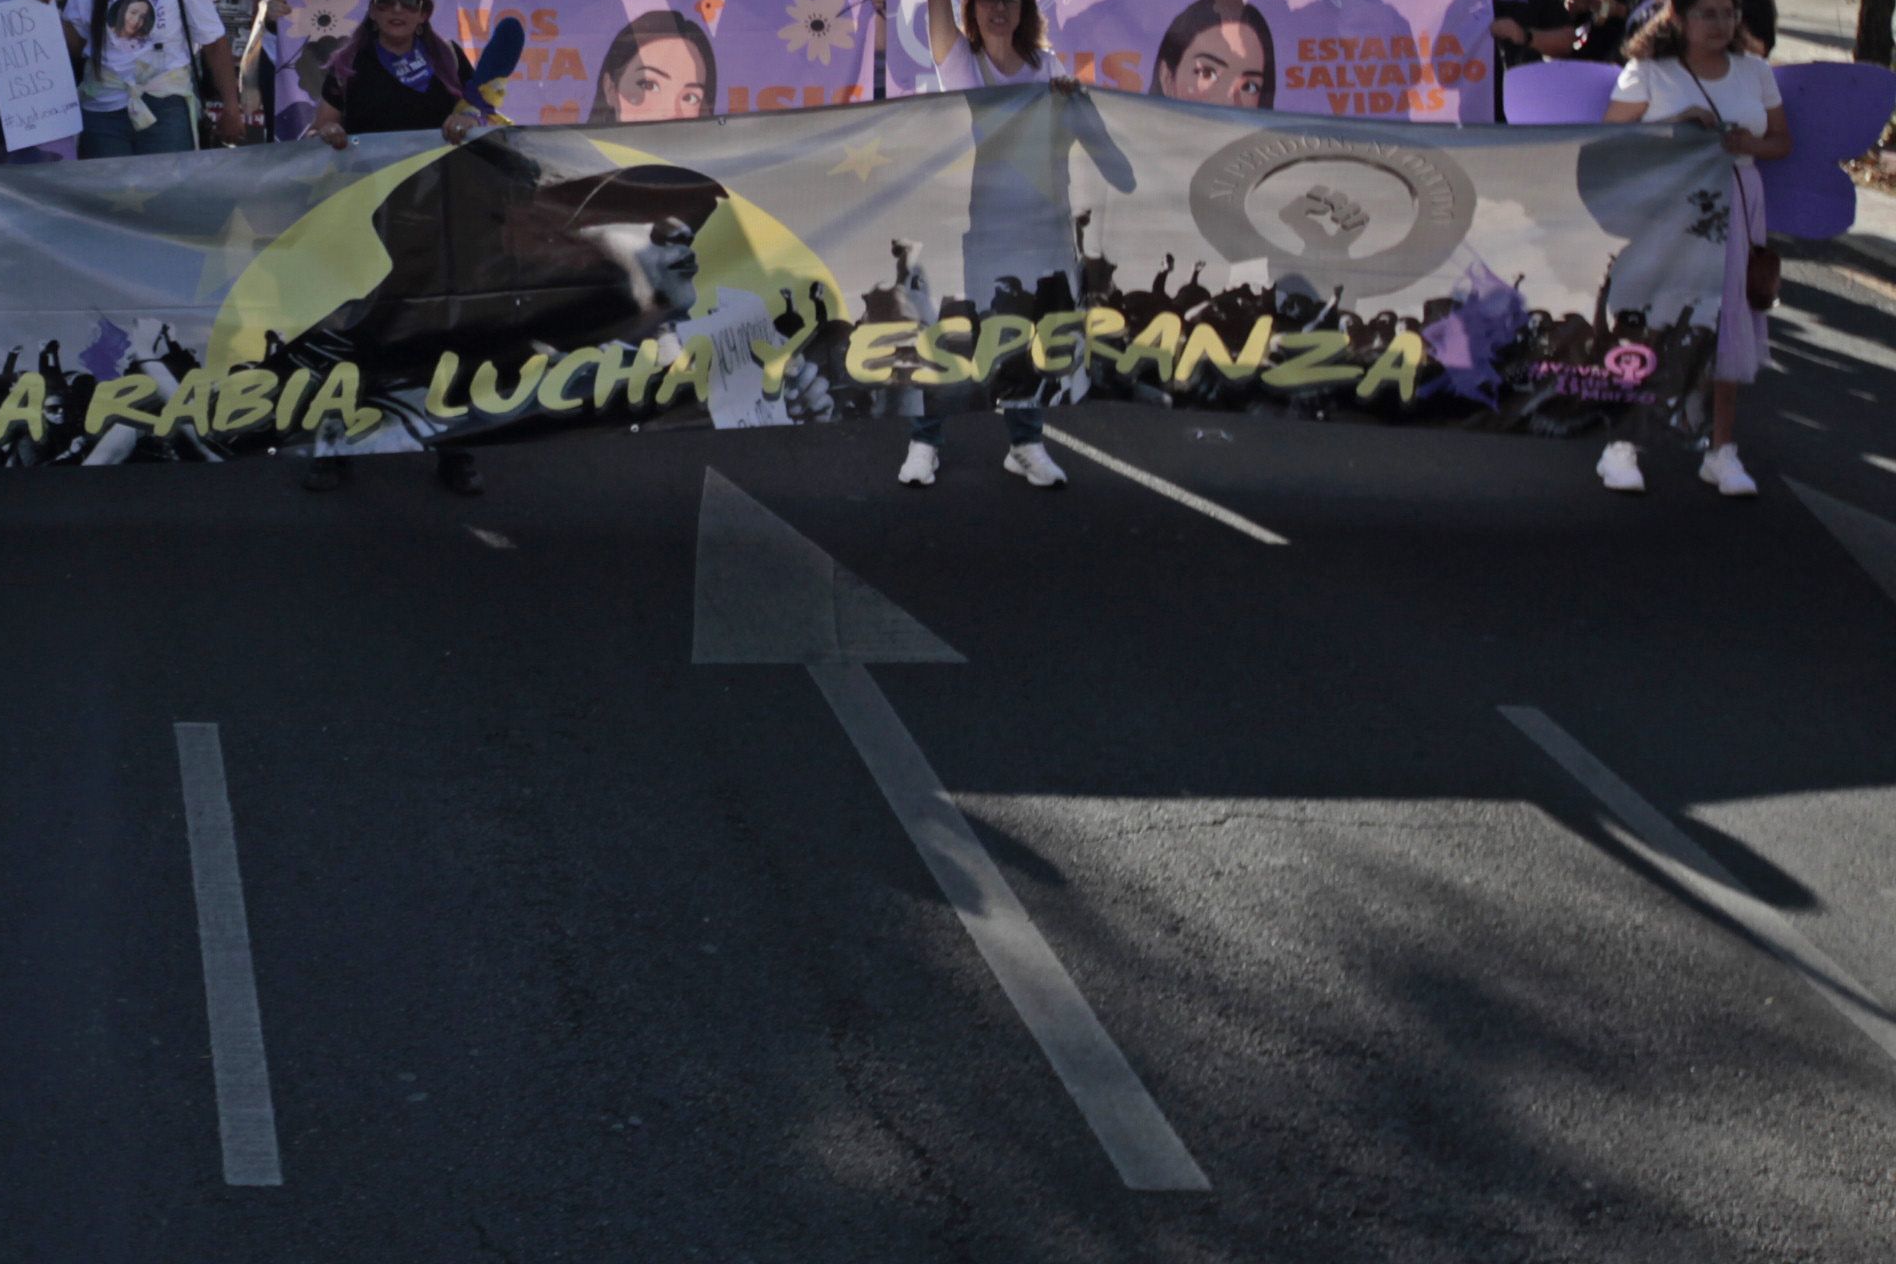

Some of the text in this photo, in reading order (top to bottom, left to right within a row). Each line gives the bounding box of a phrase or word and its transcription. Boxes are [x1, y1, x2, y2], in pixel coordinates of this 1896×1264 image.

[0, 6, 36, 38] NOS
[1297, 28, 1464, 63] ESTARÍA
[7, 70, 56, 102] ISIS
[1284, 58, 1487, 91] SALVANDO
[1326, 87, 1447, 116] VIDAS
[425, 336, 712, 423] LUCHA
[751, 319, 822, 394] Y
[845, 308, 1429, 406] ESPERANZA
